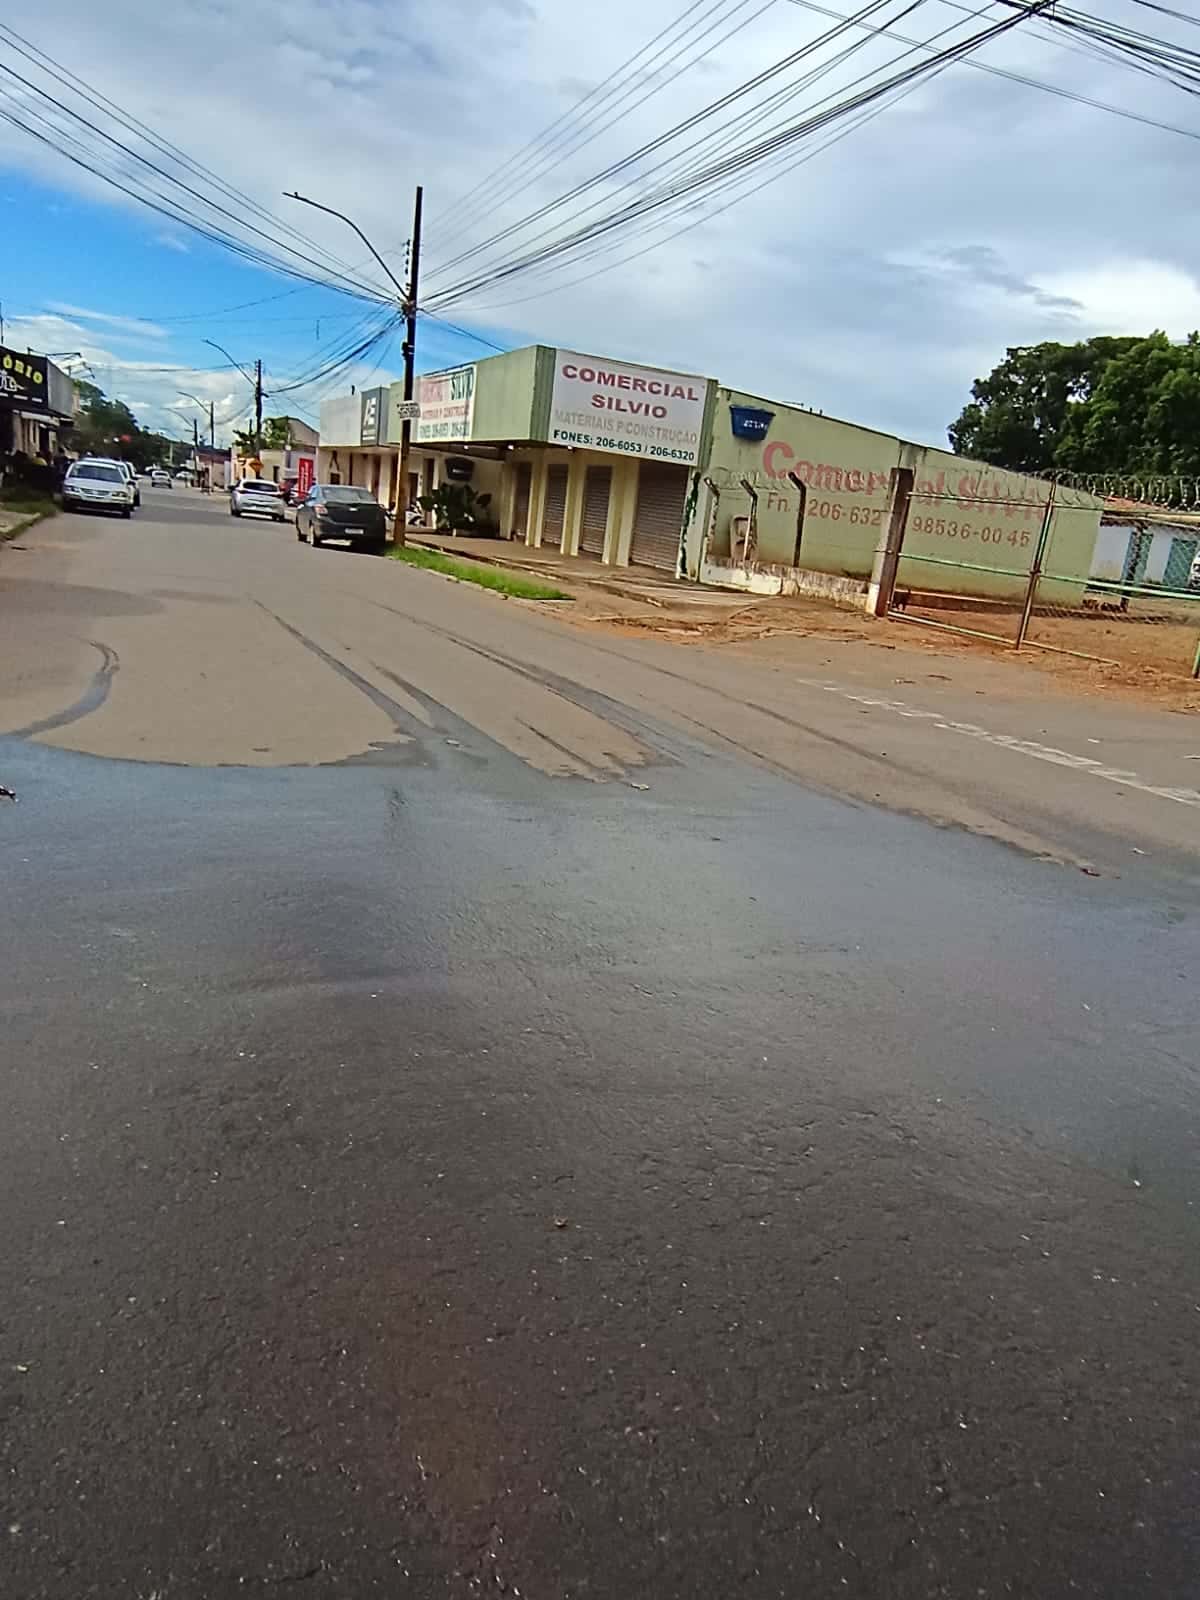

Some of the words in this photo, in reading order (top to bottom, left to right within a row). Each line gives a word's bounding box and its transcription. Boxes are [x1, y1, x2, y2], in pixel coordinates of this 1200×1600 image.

[562, 364, 699, 401] COMERCIAL
[555, 409, 614, 432] MATERIAIS
[591, 394, 667, 418] SILVIO
[553, 429, 593, 444] FONES:
[596, 437, 642, 453] 206-6053
[650, 446, 695, 462] 206-6320
[763, 441, 945, 507] Comeral
[807, 498, 882, 526] 206-632
